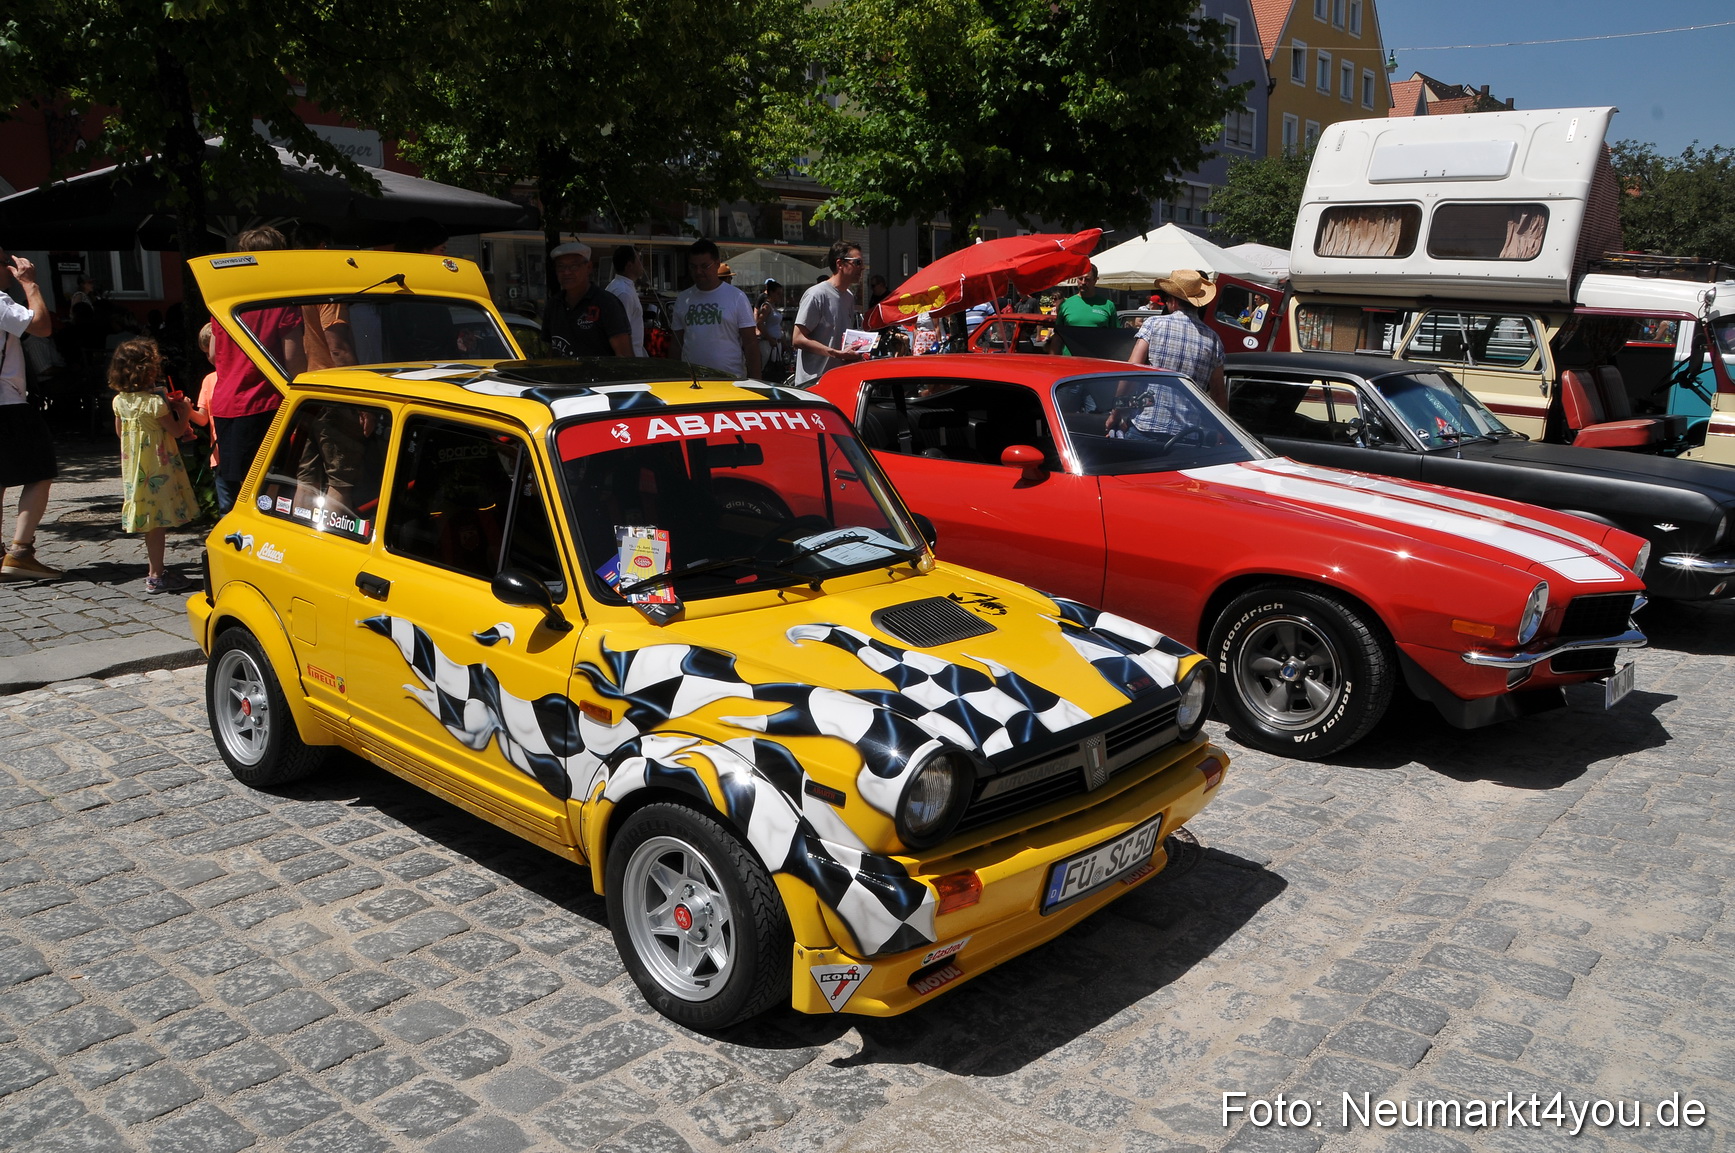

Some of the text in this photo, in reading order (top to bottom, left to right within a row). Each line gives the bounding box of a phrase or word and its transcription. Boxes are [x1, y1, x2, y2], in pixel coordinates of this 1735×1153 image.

[646, 411, 810, 440] ABARTH
[1219, 601, 1285, 674] BFGoodrich
[307, 663, 337, 688] PIRELLI
[1292, 680, 1353, 744] Radial T/A
[996, 759, 1070, 792] AUTOBIANCHI
[1060, 856, 1098, 898] FÜ
[931, 940, 965, 961] Castrol
[821, 973, 860, 983] KONI
[914, 966, 962, 994] MOTUL
